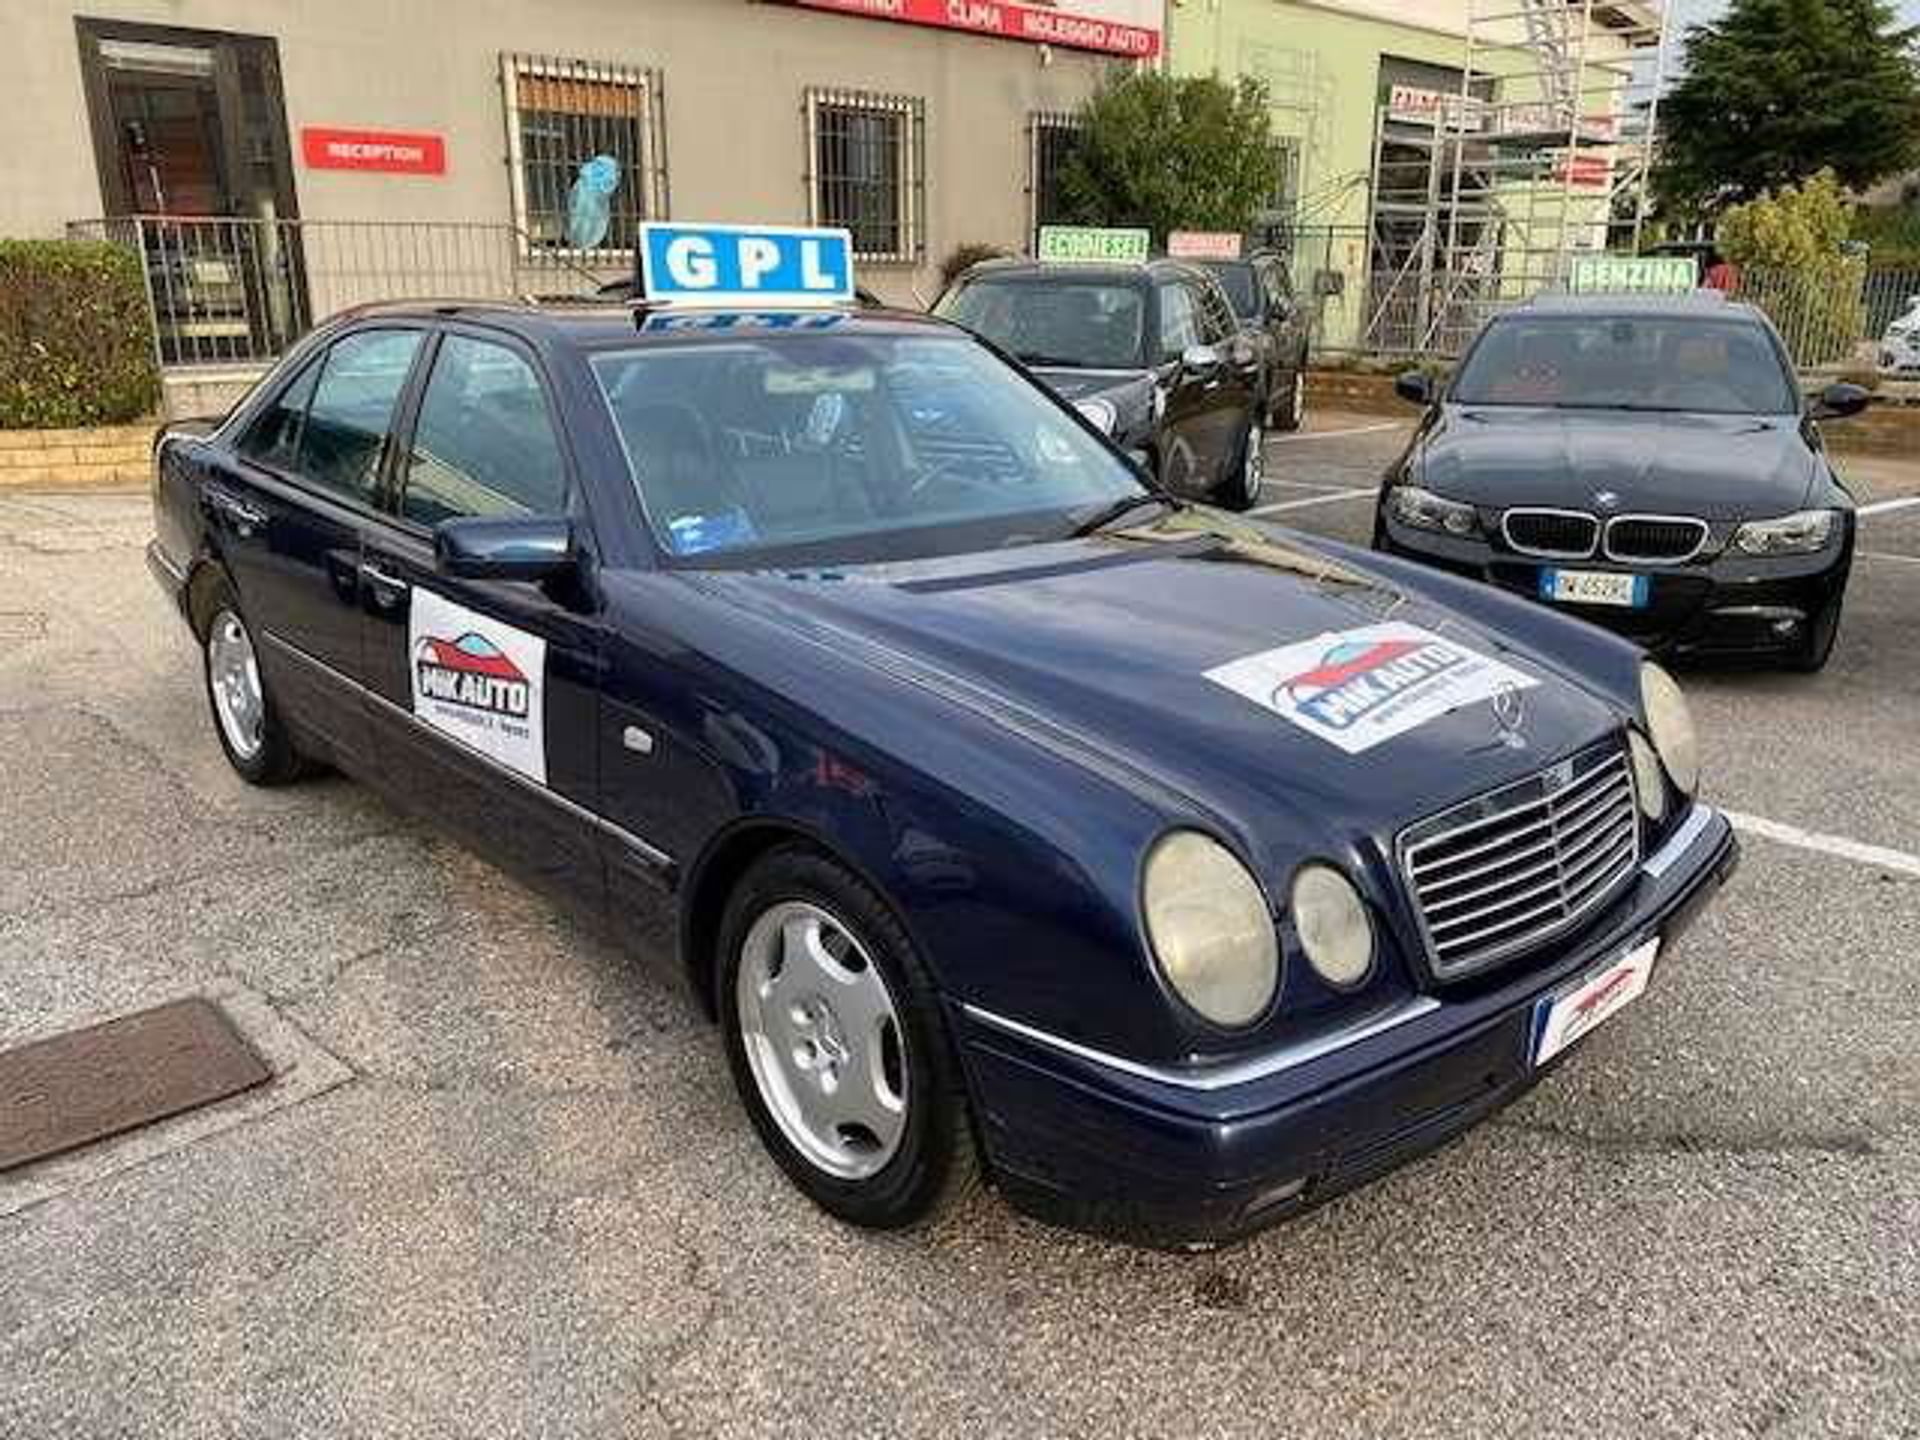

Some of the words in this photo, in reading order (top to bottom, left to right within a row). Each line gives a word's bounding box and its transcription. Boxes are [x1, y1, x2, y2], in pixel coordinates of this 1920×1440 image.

[946, 0, 1002, 32] CLIMA
[1023, 11, 1106, 46] NOLEGGIO
[1107, 25, 1149, 53] AUTO
[328, 143, 424, 162] RECEPTION
[1579, 262, 1692, 290] BENZINA
[419, 663, 528, 717] MIKAUTO
[1299, 643, 1464, 728] MIKAUTO
